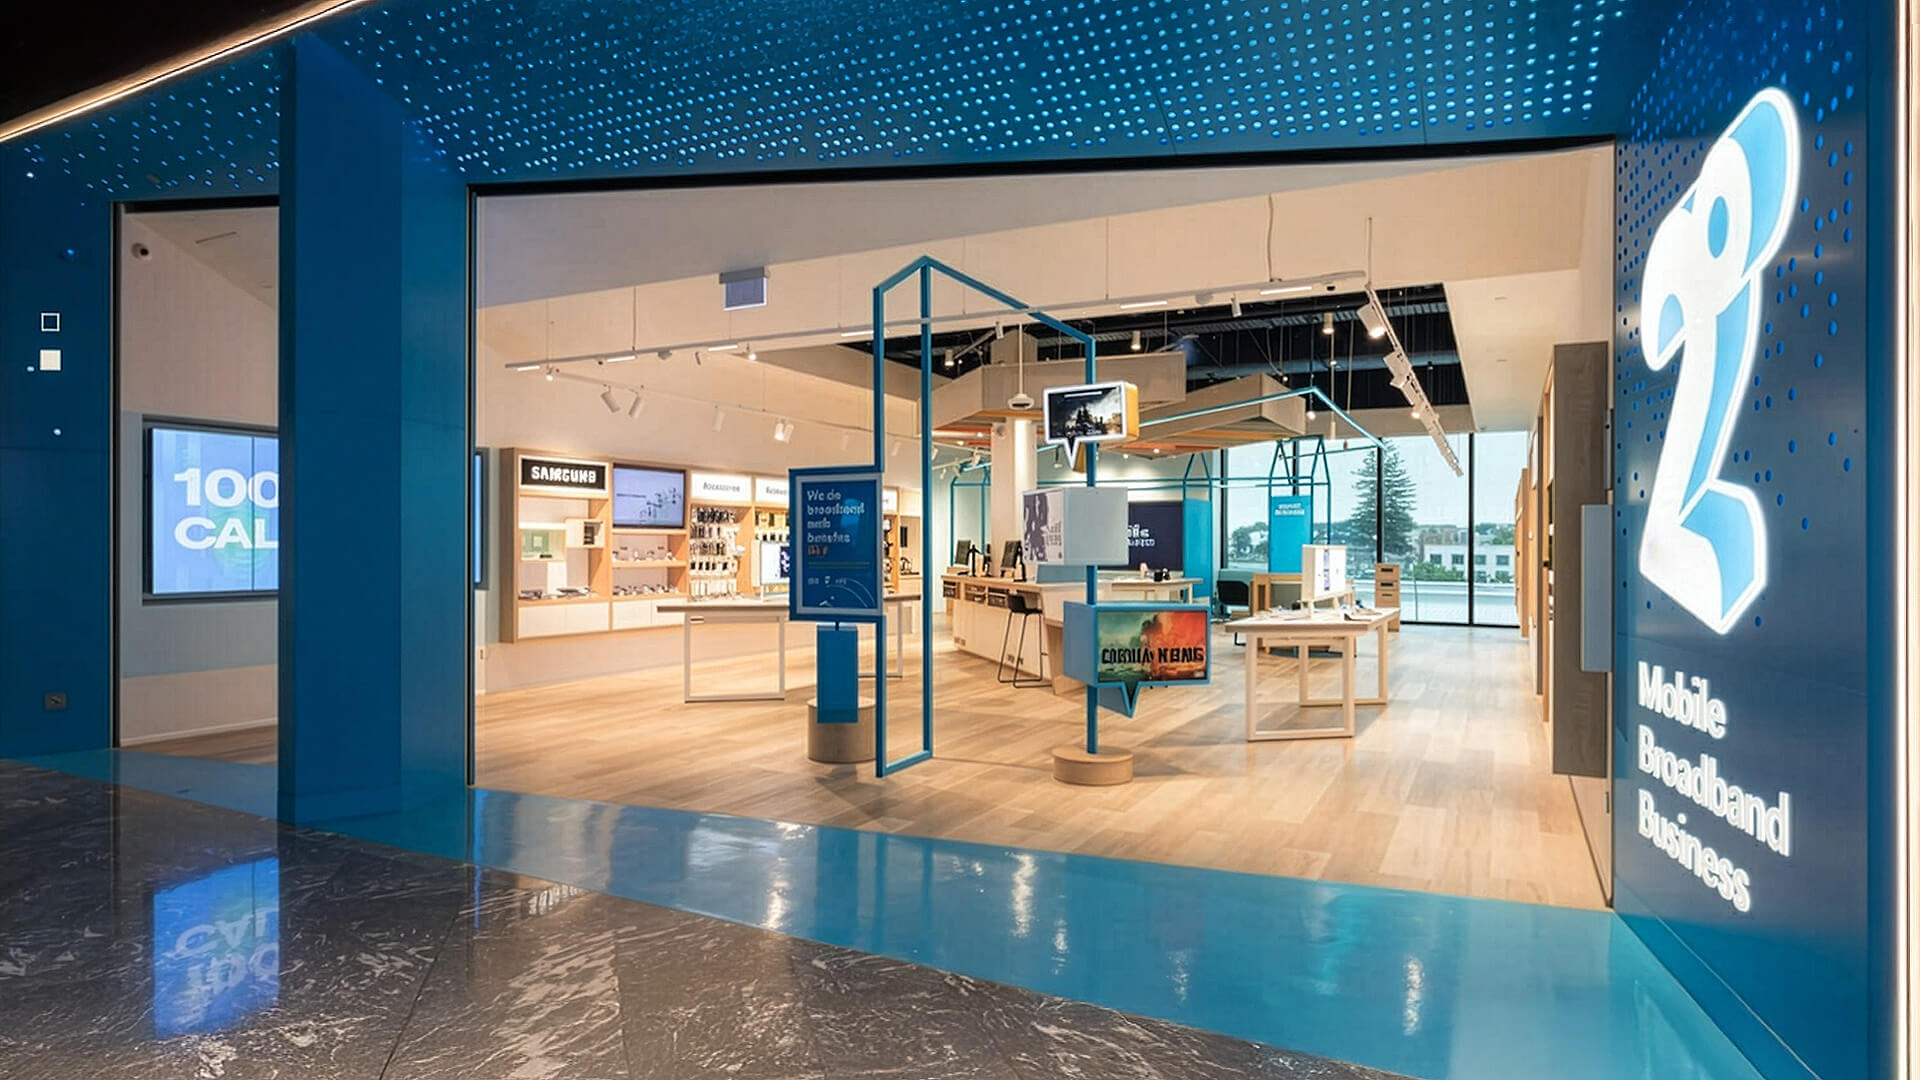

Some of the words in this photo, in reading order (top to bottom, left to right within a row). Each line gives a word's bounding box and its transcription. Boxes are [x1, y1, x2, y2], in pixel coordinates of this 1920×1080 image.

[1638, 661, 1727, 739] Mobile
[1638, 725, 1790, 857] Broadband
[1638, 789, 1751, 912] Business
